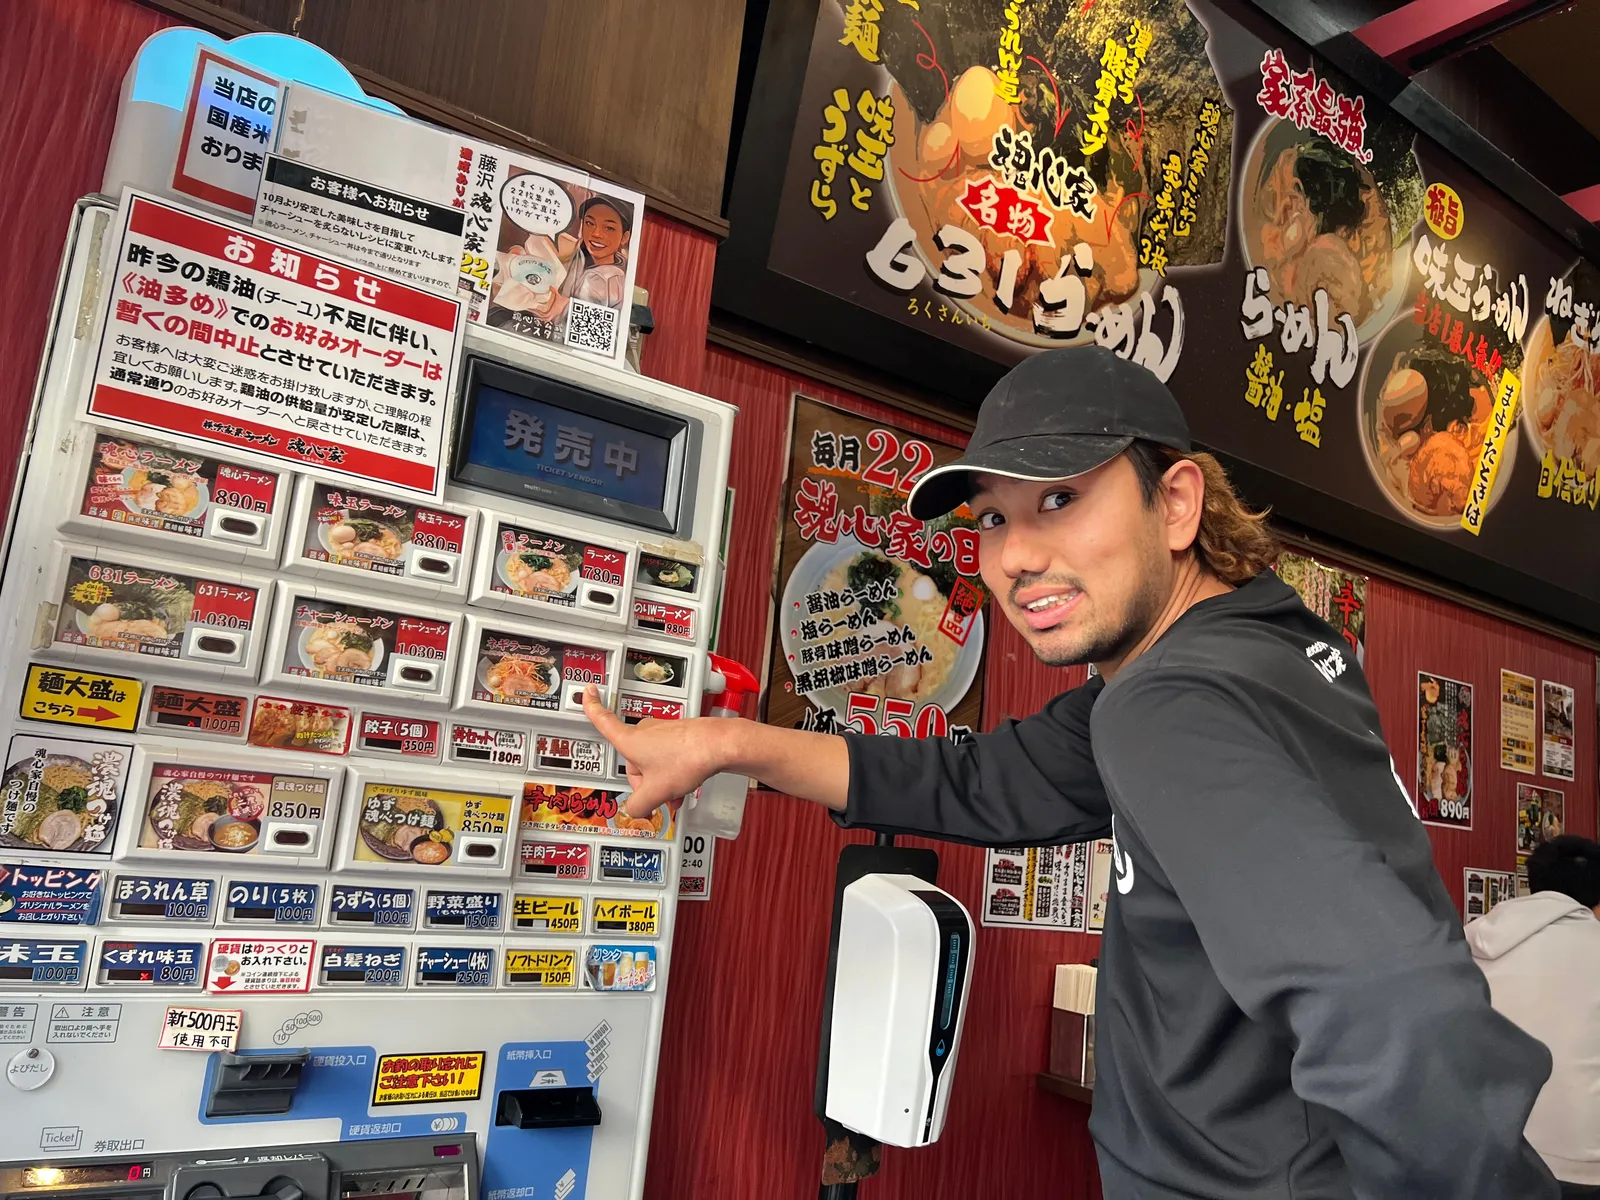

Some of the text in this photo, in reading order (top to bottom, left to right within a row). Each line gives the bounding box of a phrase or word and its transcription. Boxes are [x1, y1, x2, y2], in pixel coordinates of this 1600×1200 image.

[811, 88, 850, 220] うずら
[310, 176, 430, 221] お客様へお知らせ
[970, 188, 1036, 240] 名物
[224, 233, 383, 304] お知らせ
[1240, 267, 1359, 388] らーめん
[115, 300, 437, 406] 暫くの間中止とさせていただきます。
[503, 409, 639, 478] 発売中
[101, 441, 202, 473] 魂心ラーメン
[811, 429, 934, 494] 毎月 22
[219, 466, 272, 486] 魂心ラーメン
[536, 463, 604, 488] TICKET VENDOR
[215, 489, 268, 514] 890円
[327, 492, 407, 518] 味玉ラーメン
[417, 512, 462, 529] 味玉ラーメン
[794, 477, 980, 577] 魂心家の日
[414, 532, 458, 552] 880円
[518, 533, 565, 552] ラーメン
[586, 549, 620, 564] ラーメン
[89, 565, 178, 591] 631ラーメン
[584, 565, 620, 585] 780円
[198, 583, 252, 602] 631ラーメン
[805, 579, 898, 616] 醤油らーめん
[296, 605, 394, 629] チャーシューメン
[400, 619, 448, 636] チャーシューメン
[667, 623, 691, 635] 980円
[800, 608, 878, 642] 塩らーめん
[486, 637, 550, 655] ネギラーメン
[800, 625, 916, 666] 豚骨味噌らーめん
[565, 649, 602, 662] ネギラーメン
[564, 667, 602, 684] 980円
[795, 646, 933, 695] 黒胡椒味噌らーめん
[37, 671, 126, 703] 麺大盛は
[33, 702, 75, 717] こちら
[153, 691, 241, 718] 麺大盛
[620, 698, 680, 717] 野菜ラーメン
[204, 717, 240, 733] 100円
[364, 720, 429, 738] 餃子(5個)
[403, 740, 434, 753] 350円
[492, 750, 522, 764] 180円
[573, 760, 600, 772] 350円
[22, 747, 48, 814] 魂心家自慢の
[372, 786, 428, 798] さっぱりゆず風味
[1, 779, 23, 834] つけ麺です
[272, 801, 321, 819] 850円
[368, 797, 396, 810] ゆず
[465, 800, 482, 808] ゆず
[1440, 798, 1470, 821] 890円
[364, 809, 436, 829] 魂心つけ麺
[462, 820, 504, 833] 850円
[521, 845, 587, 860] 辛肉ラーメン
[600, 850, 660, 868] 辛肉トッピング
[557, 864, 587, 876] 880円
[634, 868, 661, 880] 100円
[11, 868, 102, 890] トッピング
[22, 891, 92, 899] お好きなトッピングで
[115, 880, 210, 902] ほうれん草
[229, 886, 316, 905] のり(5枚)
[20, 902, 90, 910] オリジナルラーメンを
[332, 891, 411, 909] うずら(5個)
[427, 895, 498, 909] 野菜盛り
[168, 903, 208, 917] 100円
[277, 907, 313, 920] 100円
[513, 900, 579, 916] 生ビール
[594, 904, 655, 919] ハイボール
[377, 911, 410, 924] 100円
[466, 915, 498, 928] 150円
[551, 918, 579, 929] 450円
[628, 921, 655, 932] 380円
[103, 949, 193, 964] くずれ味玉
[217, 943, 309, 955] 硬貨はゆっくりと
[240, 955, 308, 966] お入れ下さい。
[323, 953, 400, 968] 白髪ねぎ
[419, 951, 489, 970] チャーシュー(4枚)
[507, 955, 573, 966] ソフトドリンク
[37, 966, 78, 980] 100円
[160, 966, 195, 980] 80円
[367, 969, 400, 982] 200円
[457, 972, 489, 983] 250円
[545, 972, 571, 983] 150円
[81, 1006, 110, 1018] 注意
[308, 1014, 321, 1023] 500
[285, 1024, 295, 1032] 50
[295, 1017, 307, 1027] 100
[52, 1031, 111, 1039] 入れないでください
[173, 1035, 233, 1048] 使用不可
[276, 1034, 287, 1042] 10
[313, 1055, 367, 1067] 硬貨投入口
[507, 1050, 552, 1061] 紙幣挿入口
[10, 1063, 48, 1075] よびだし
[349, 1123, 402, 1136] 硬貨返却口
[45, 1132, 75, 1144] Ticket
[93, 1139, 145, 1153] 券取出口
[487, 1187, 534, 1200] 紙幣返却口
